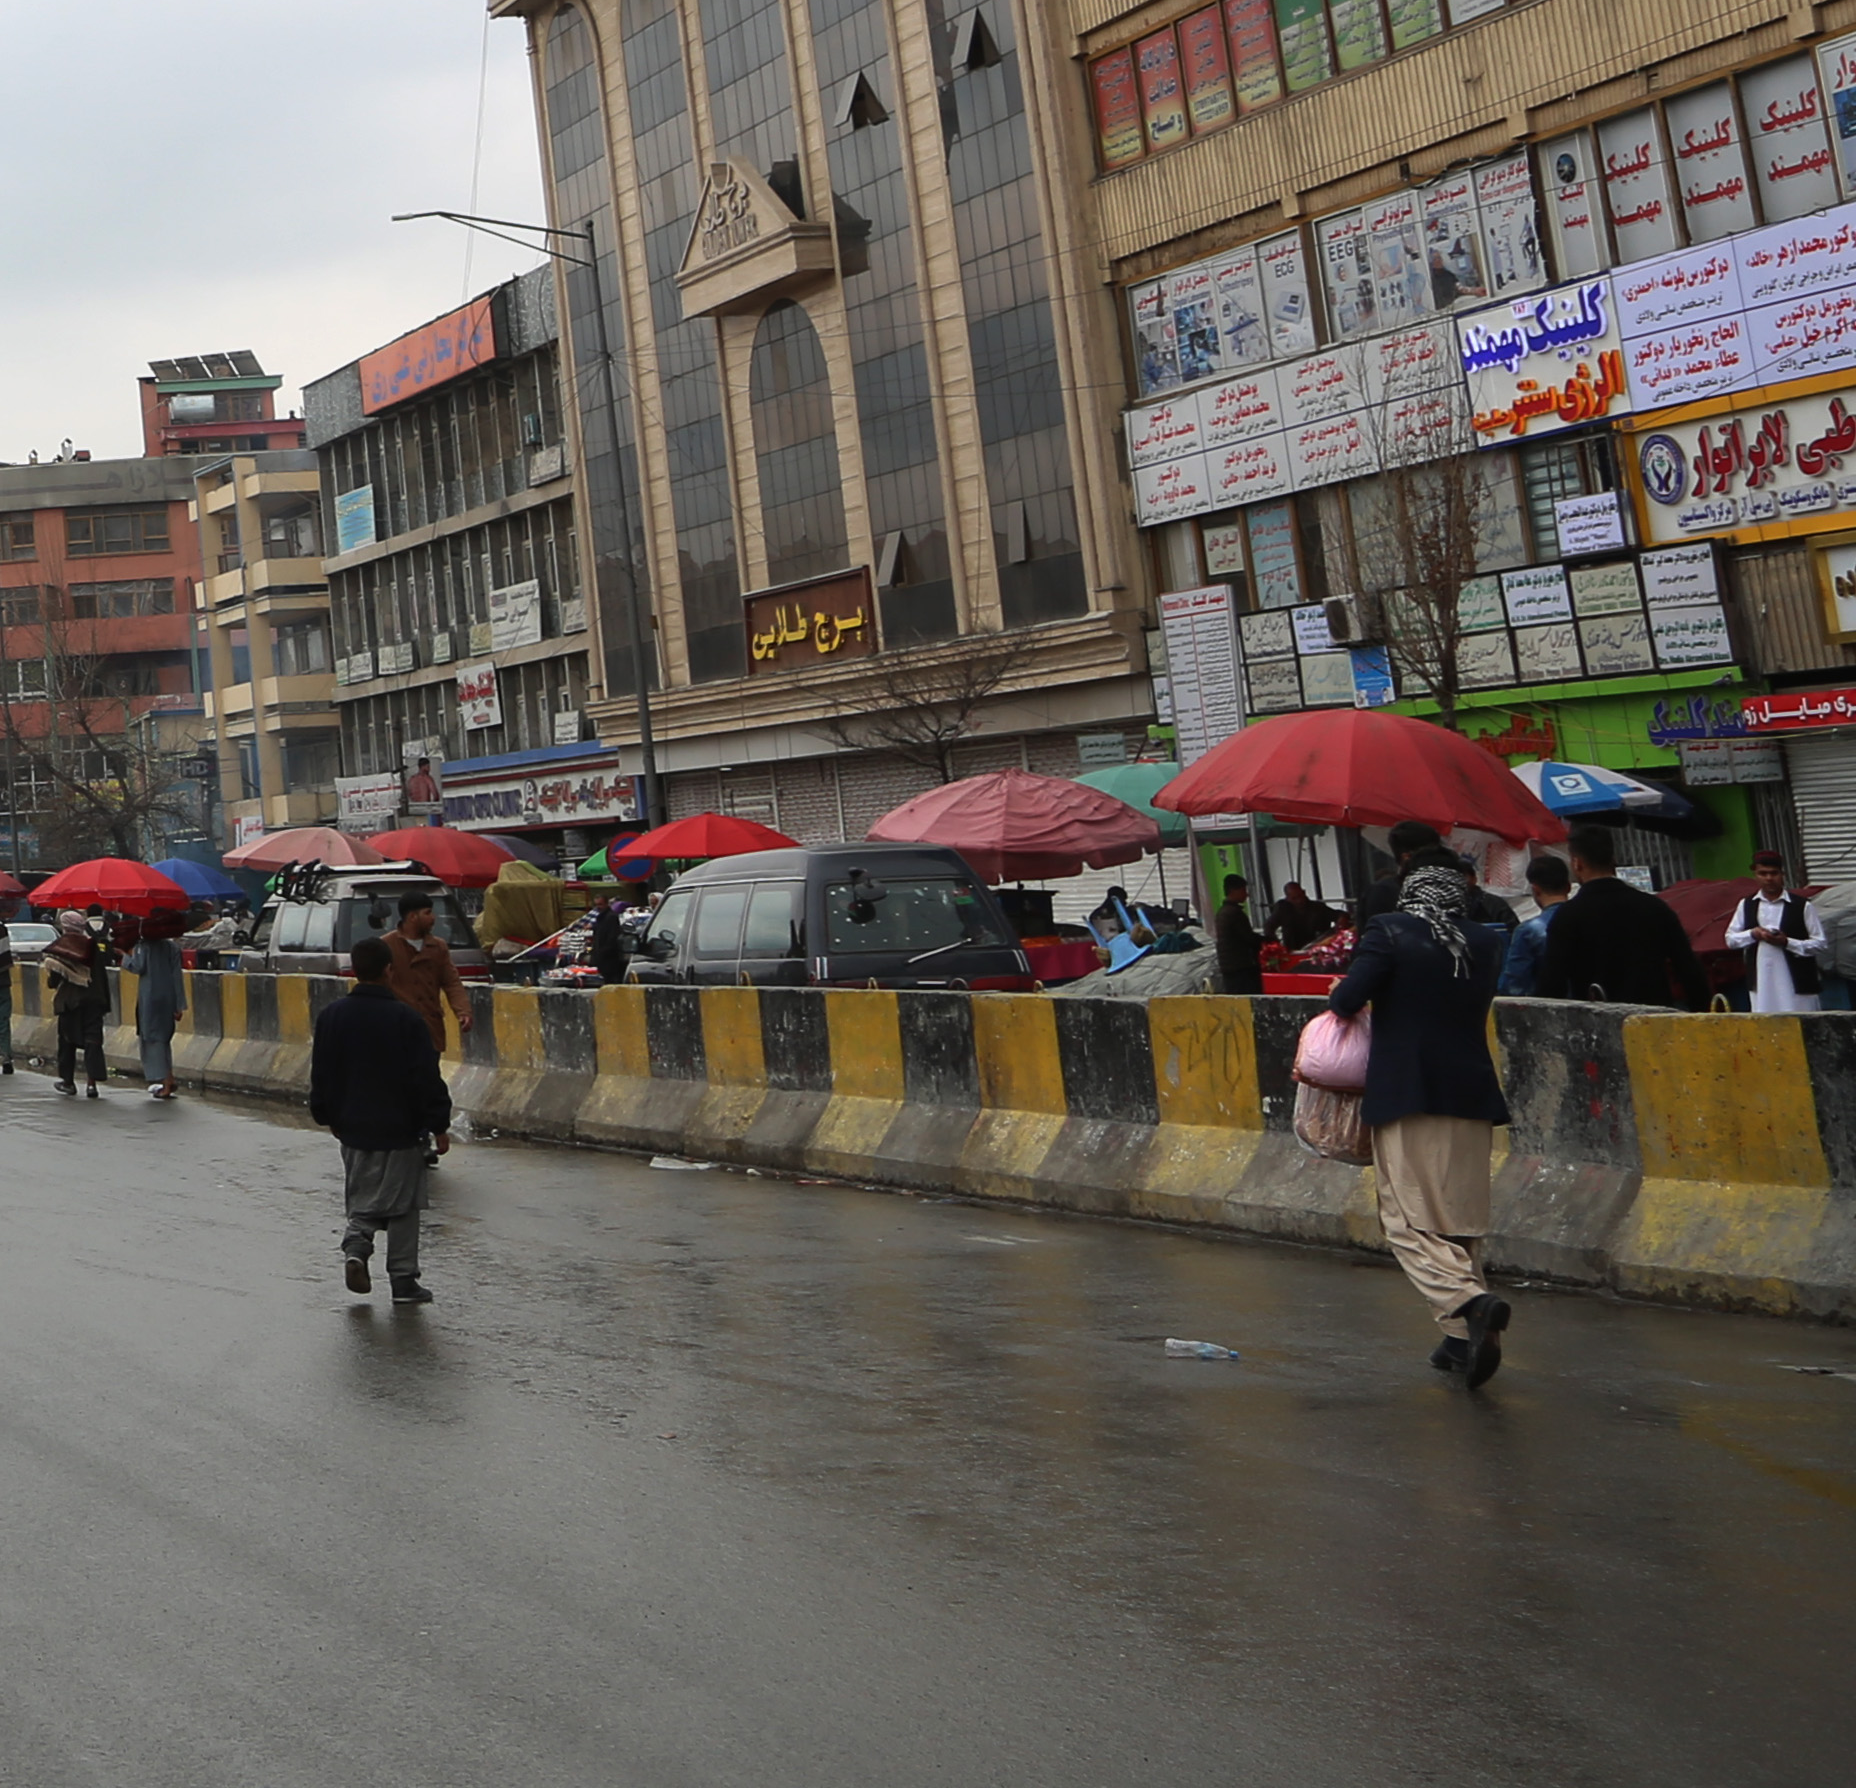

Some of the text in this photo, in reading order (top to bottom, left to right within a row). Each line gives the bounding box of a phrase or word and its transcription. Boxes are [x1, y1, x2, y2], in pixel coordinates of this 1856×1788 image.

[1760, 88, 1816, 133] کلینیک
[1678, 118, 1731, 161] کلینیک
[1605, 142, 1650, 184] کلینیک
[1767, 148, 1830, 181] مهمند
[1685, 176, 1743, 207] مهمند
[1614, 197, 1662, 226] مهمن
[1328, 241, 1354, 263] EEG
[1799, 235, 1828, 254] محمد
[1275, 260, 1295, 279] ECG
[1661, 266, 1686, 291] پلوشه
[1688, 257, 1729, 287] دوکتورس
[1462, 281, 1608, 374] کلینیک مهمند
[1775, 305, 1817, 328] دوکتورس
[1634, 321, 1739, 367] الحاج دوکتور
[1685, 358, 1713, 375] محمد
[1557, 349, 1625, 423] الرژی
[1510, 379, 1558, 435] سنتر
[1692, 397, 1856, 498] طبی لابراتوار
[814, 605, 864, 654] برج
[1759, 697, 1831, 725] مبایل
